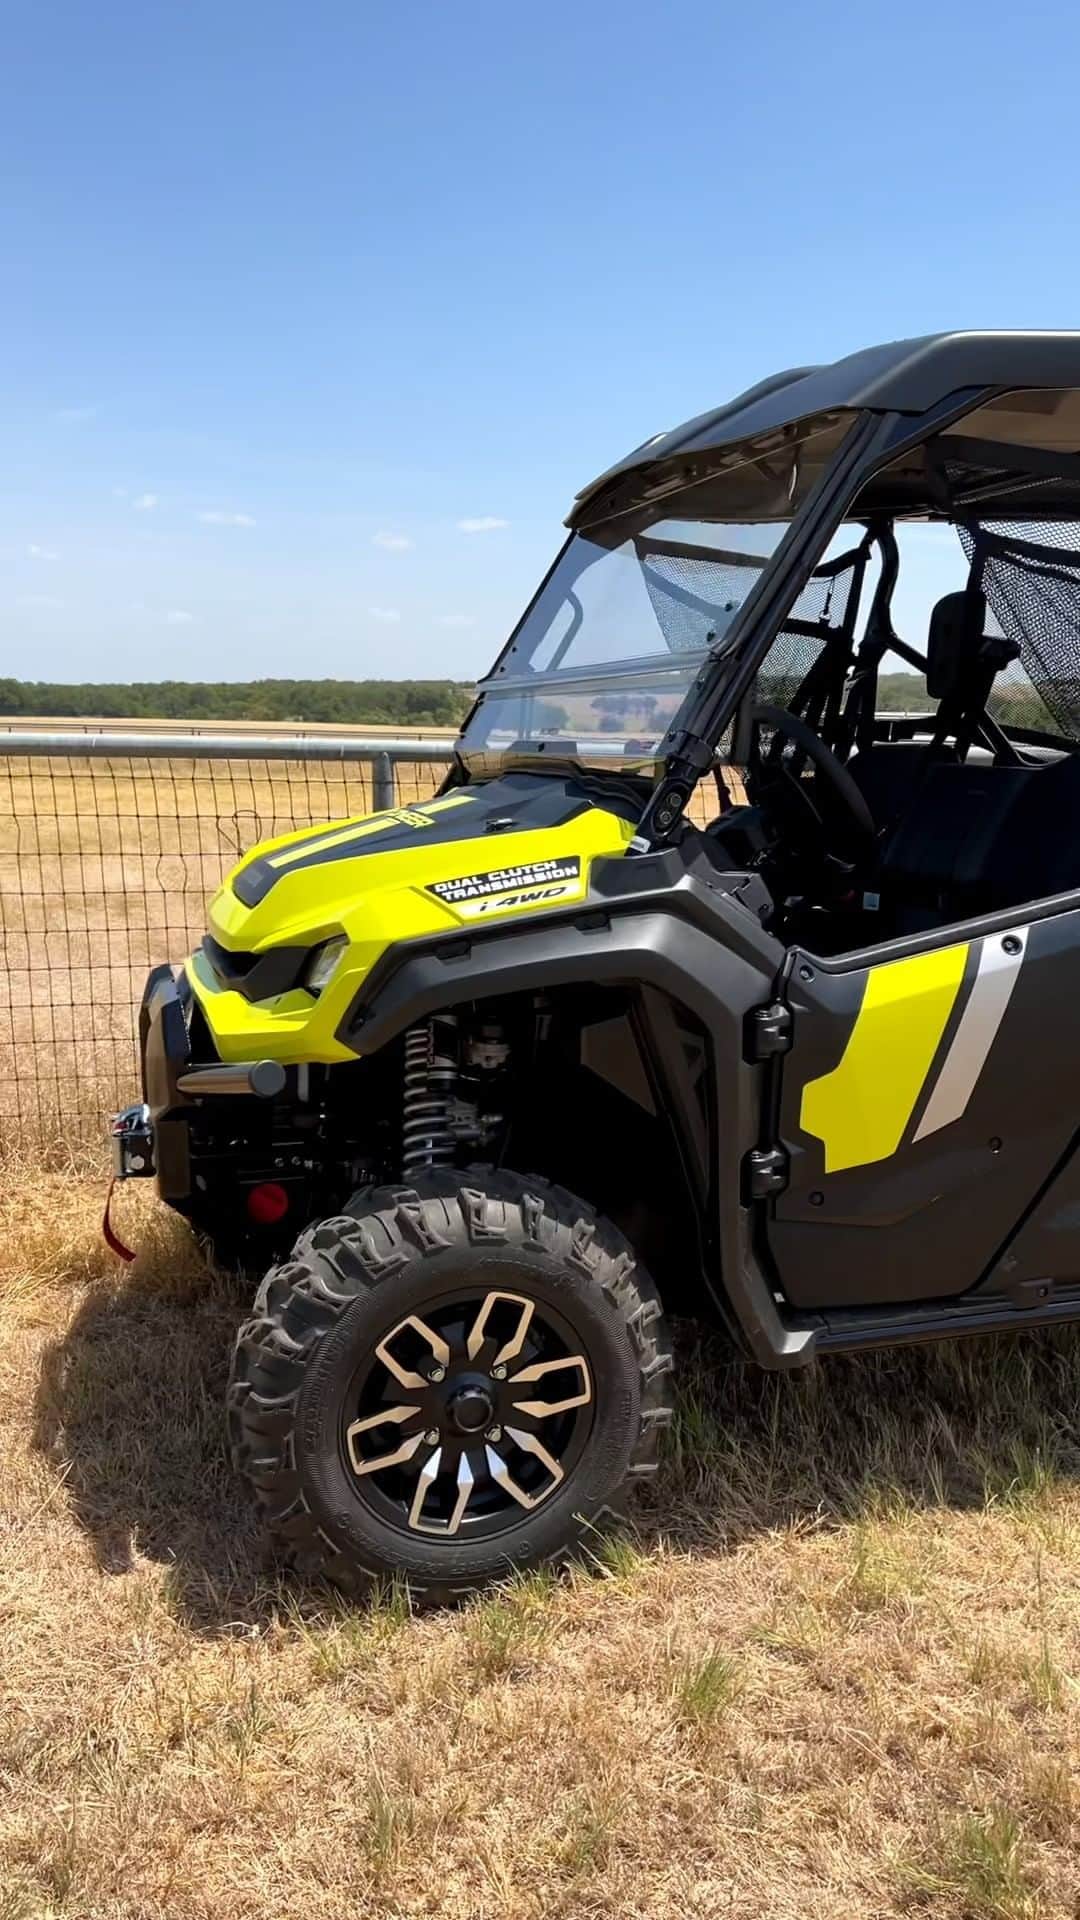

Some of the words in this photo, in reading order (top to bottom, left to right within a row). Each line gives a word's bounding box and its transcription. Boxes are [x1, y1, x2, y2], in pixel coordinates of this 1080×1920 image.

[434, 876, 483, 893] DUAL
[487, 861, 557, 880] CLUTCH
[441, 866, 578, 901] TRANSMISSION
